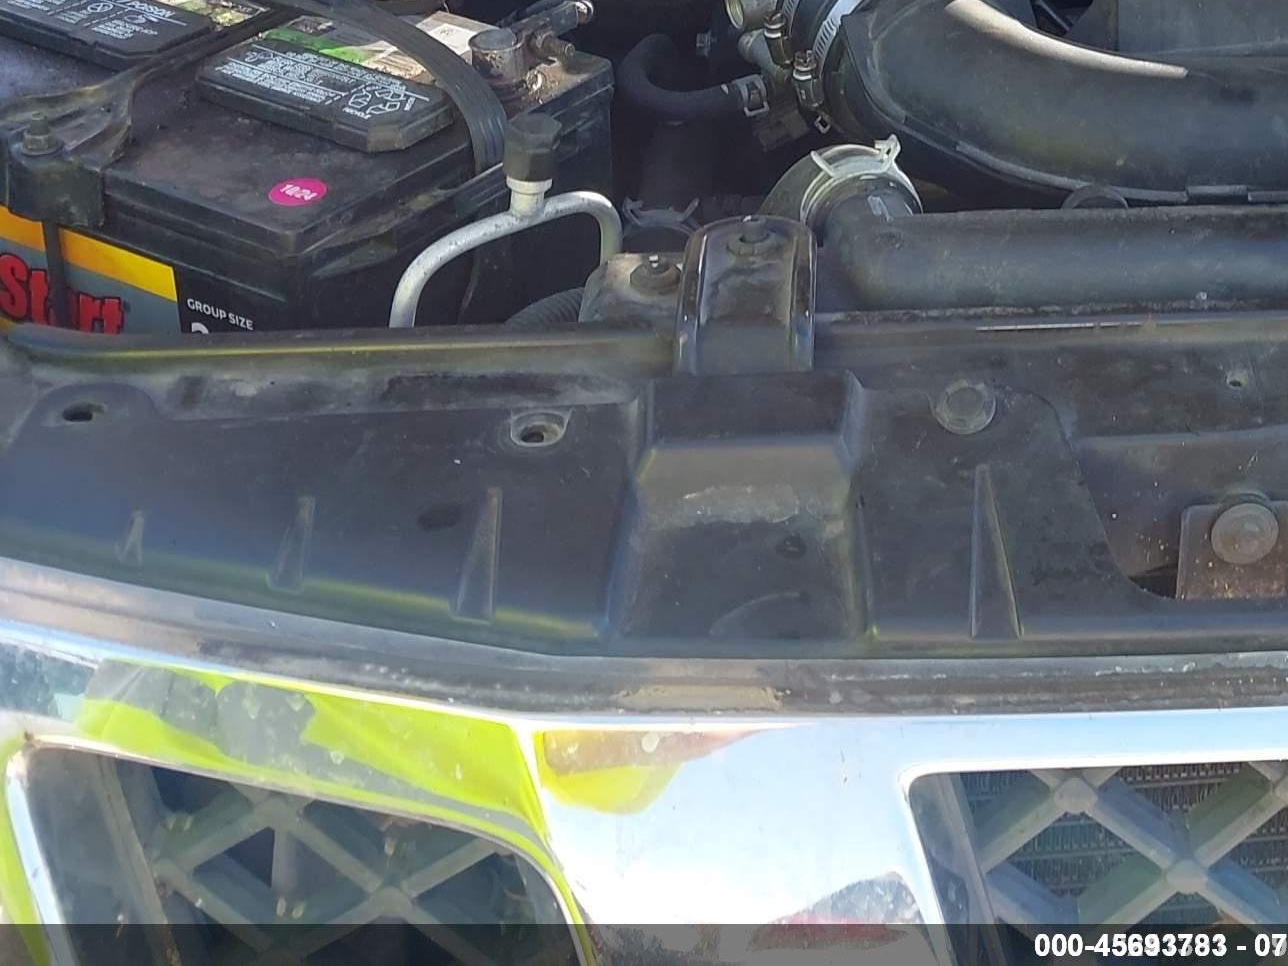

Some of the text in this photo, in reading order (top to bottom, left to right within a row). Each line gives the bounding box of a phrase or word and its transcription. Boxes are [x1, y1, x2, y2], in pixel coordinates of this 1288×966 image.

[127, 0, 176, 19] POISON
[187, 298, 227, 320] GROUP
[228, 312, 254, 330] SIZE
